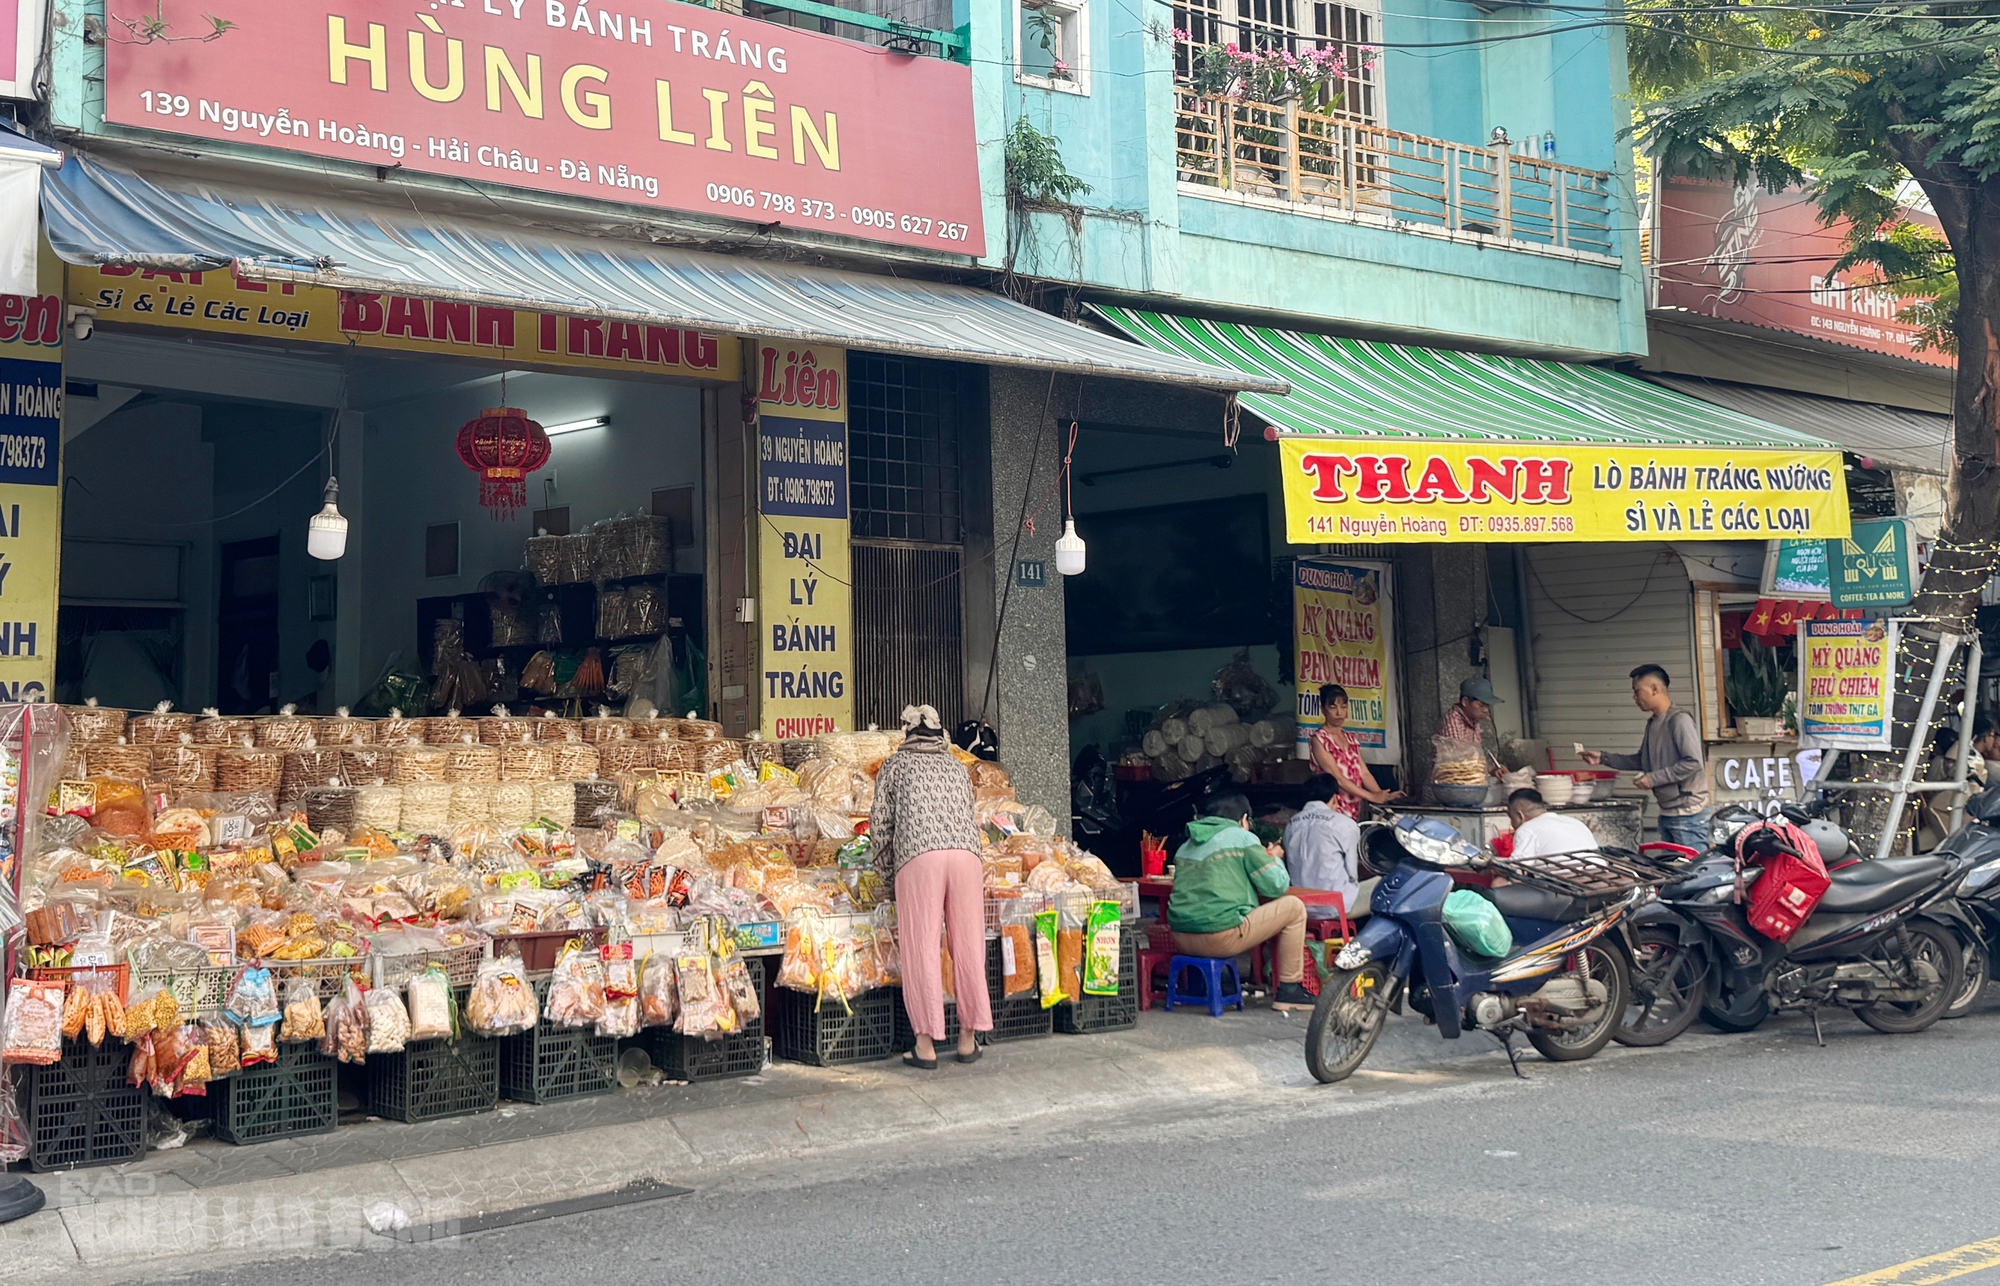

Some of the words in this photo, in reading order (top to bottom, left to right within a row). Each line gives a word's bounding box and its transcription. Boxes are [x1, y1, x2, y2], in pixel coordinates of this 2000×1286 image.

[545, 0, 652, 47] BÁNH
[667, 24, 787, 74] TRÁNG
[327, 12, 613, 131] HÙNG
[656, 79, 842, 172] LIÊN
[139, 90, 190, 117] 139
[199, 98, 309, 137] Nguyễn
[318, 119, 405, 157] Hoàng
[428, 136, 470, 163] Hải
[477, 145, 539, 174] Châu
[559, 158, 591, 182] Đà
[598, 164, 659, 198] Nẵng
[706, 182, 755, 207] 0906
[760, 191, 796, 214] 798
[801, 199, 835, 220] 373
[851, 206, 896, 230] 0905
[900, 215, 932, 236] 627
[937, 221, 969, 243] 267
[96, 288, 123, 309] Sỉ
[133, 294, 154, 313] &
[165, 295, 196, 316] Lẻ
[204, 300, 249, 321] Các
[257, 306, 310, 331] Loại
[1810, 315, 1821, 328] ĐC:
[1822, 317, 1833, 330] 143
[1833, 319, 1859, 335] NGUYỄN
[1859, 325, 1881, 339] HOÀNG
[758, 346, 841, 409] Liên
[15, 378, 61, 419] HOÀNG
[760, 435, 772, 461] 39
[775, 427, 811, 464] NGUYỄN
[814, 434, 843, 467] HOÀNG
[767, 476, 783, 501] ĐT:
[784, 477, 835, 506] 0906.798373
[1302, 455, 1573, 504] THANH
[1593, 459, 1622, 490] LÒ
[1629, 460, 1687, 490] BÁNH
[1694, 462, 1762, 490] TRÁNG
[1768, 464, 1832, 491] NƯỚNG
[1307, 516, 1333, 532] 141
[1340, 513, 1397, 536] Nguyễn
[1401, 515, 1447, 536] Hoàng
[1459, 516, 1484, 532] ĐT:
[1488, 516, 1574, 532] 0935.897.568
[1625, 500, 1648, 531] SỈ
[1652, 502, 1682, 530] VÀ
[1689, 499, 1714, 530] LẺ
[1721, 502, 1760, 530] CÁC
[1767, 508, 1811, 534] LOẠI
[783, 532, 822, 568] ĐẠI
[790, 571, 818, 605] LÝ
[1020, 563, 1041, 580] 141
[1299, 566, 1329, 588] DUNG
[1331, 568, 1354, 591] HOÀI
[1840, 592, 1879, 603] COFFEE-TEA
[1879, 592, 1885, 600] &
[1885, 591, 1906, 600] MORE
[772, 617, 836, 652] BÁNH
[1325, 600, 1375, 646] QUẢNG
[1812, 622, 1837, 635] DUNG
[1839, 620, 1862, 634] HOÀI
[1333, 649, 1383, 689] CHIÊM
[1834, 640, 1880, 671] QUẢNG
[765, 664, 844, 699] TRÁNG
[1838, 672, 1880, 697] CHIÊM
[1298, 691, 1320, 717] TÔM
[1349, 698, 1368, 726] THỊT
[1370, 696, 1383, 721] GÀ
[1808, 702, 1823, 716] TÔM
[1849, 702, 1866, 719] THỊT
[1867, 701, 1878, 716] GÀ
[1723, 757, 1792, 790] CAFE
